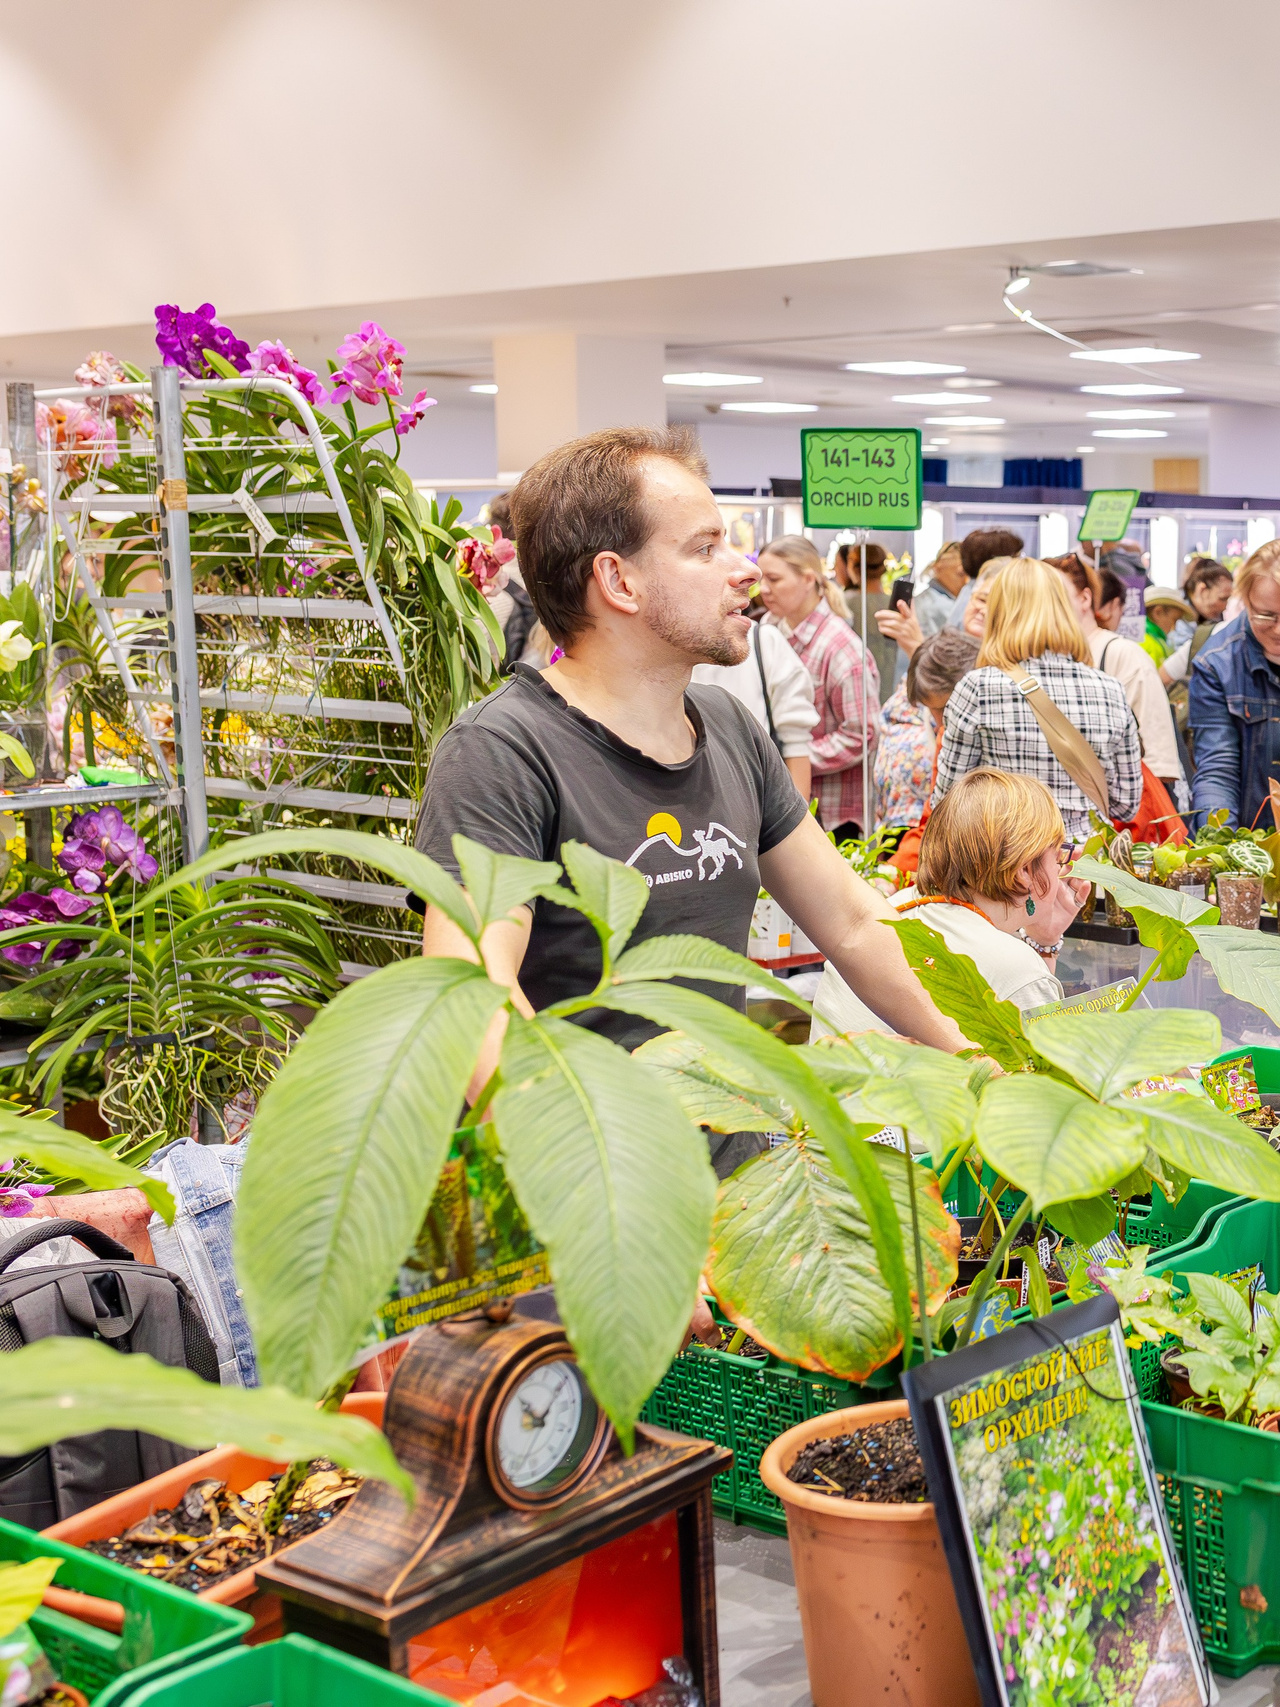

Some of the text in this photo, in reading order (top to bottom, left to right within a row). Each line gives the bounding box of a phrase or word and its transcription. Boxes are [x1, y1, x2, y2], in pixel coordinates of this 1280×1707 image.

[821, 448, 896, 468] 141-143
[810, 491, 910, 507] ORCHID RUS
[655, 869, 693, 885] ABISKO
[950, 1338, 1108, 1429] ЗИМОСТОЙКИЕ
[984, 1385, 1088, 1453] ОРХИДЕИ!
